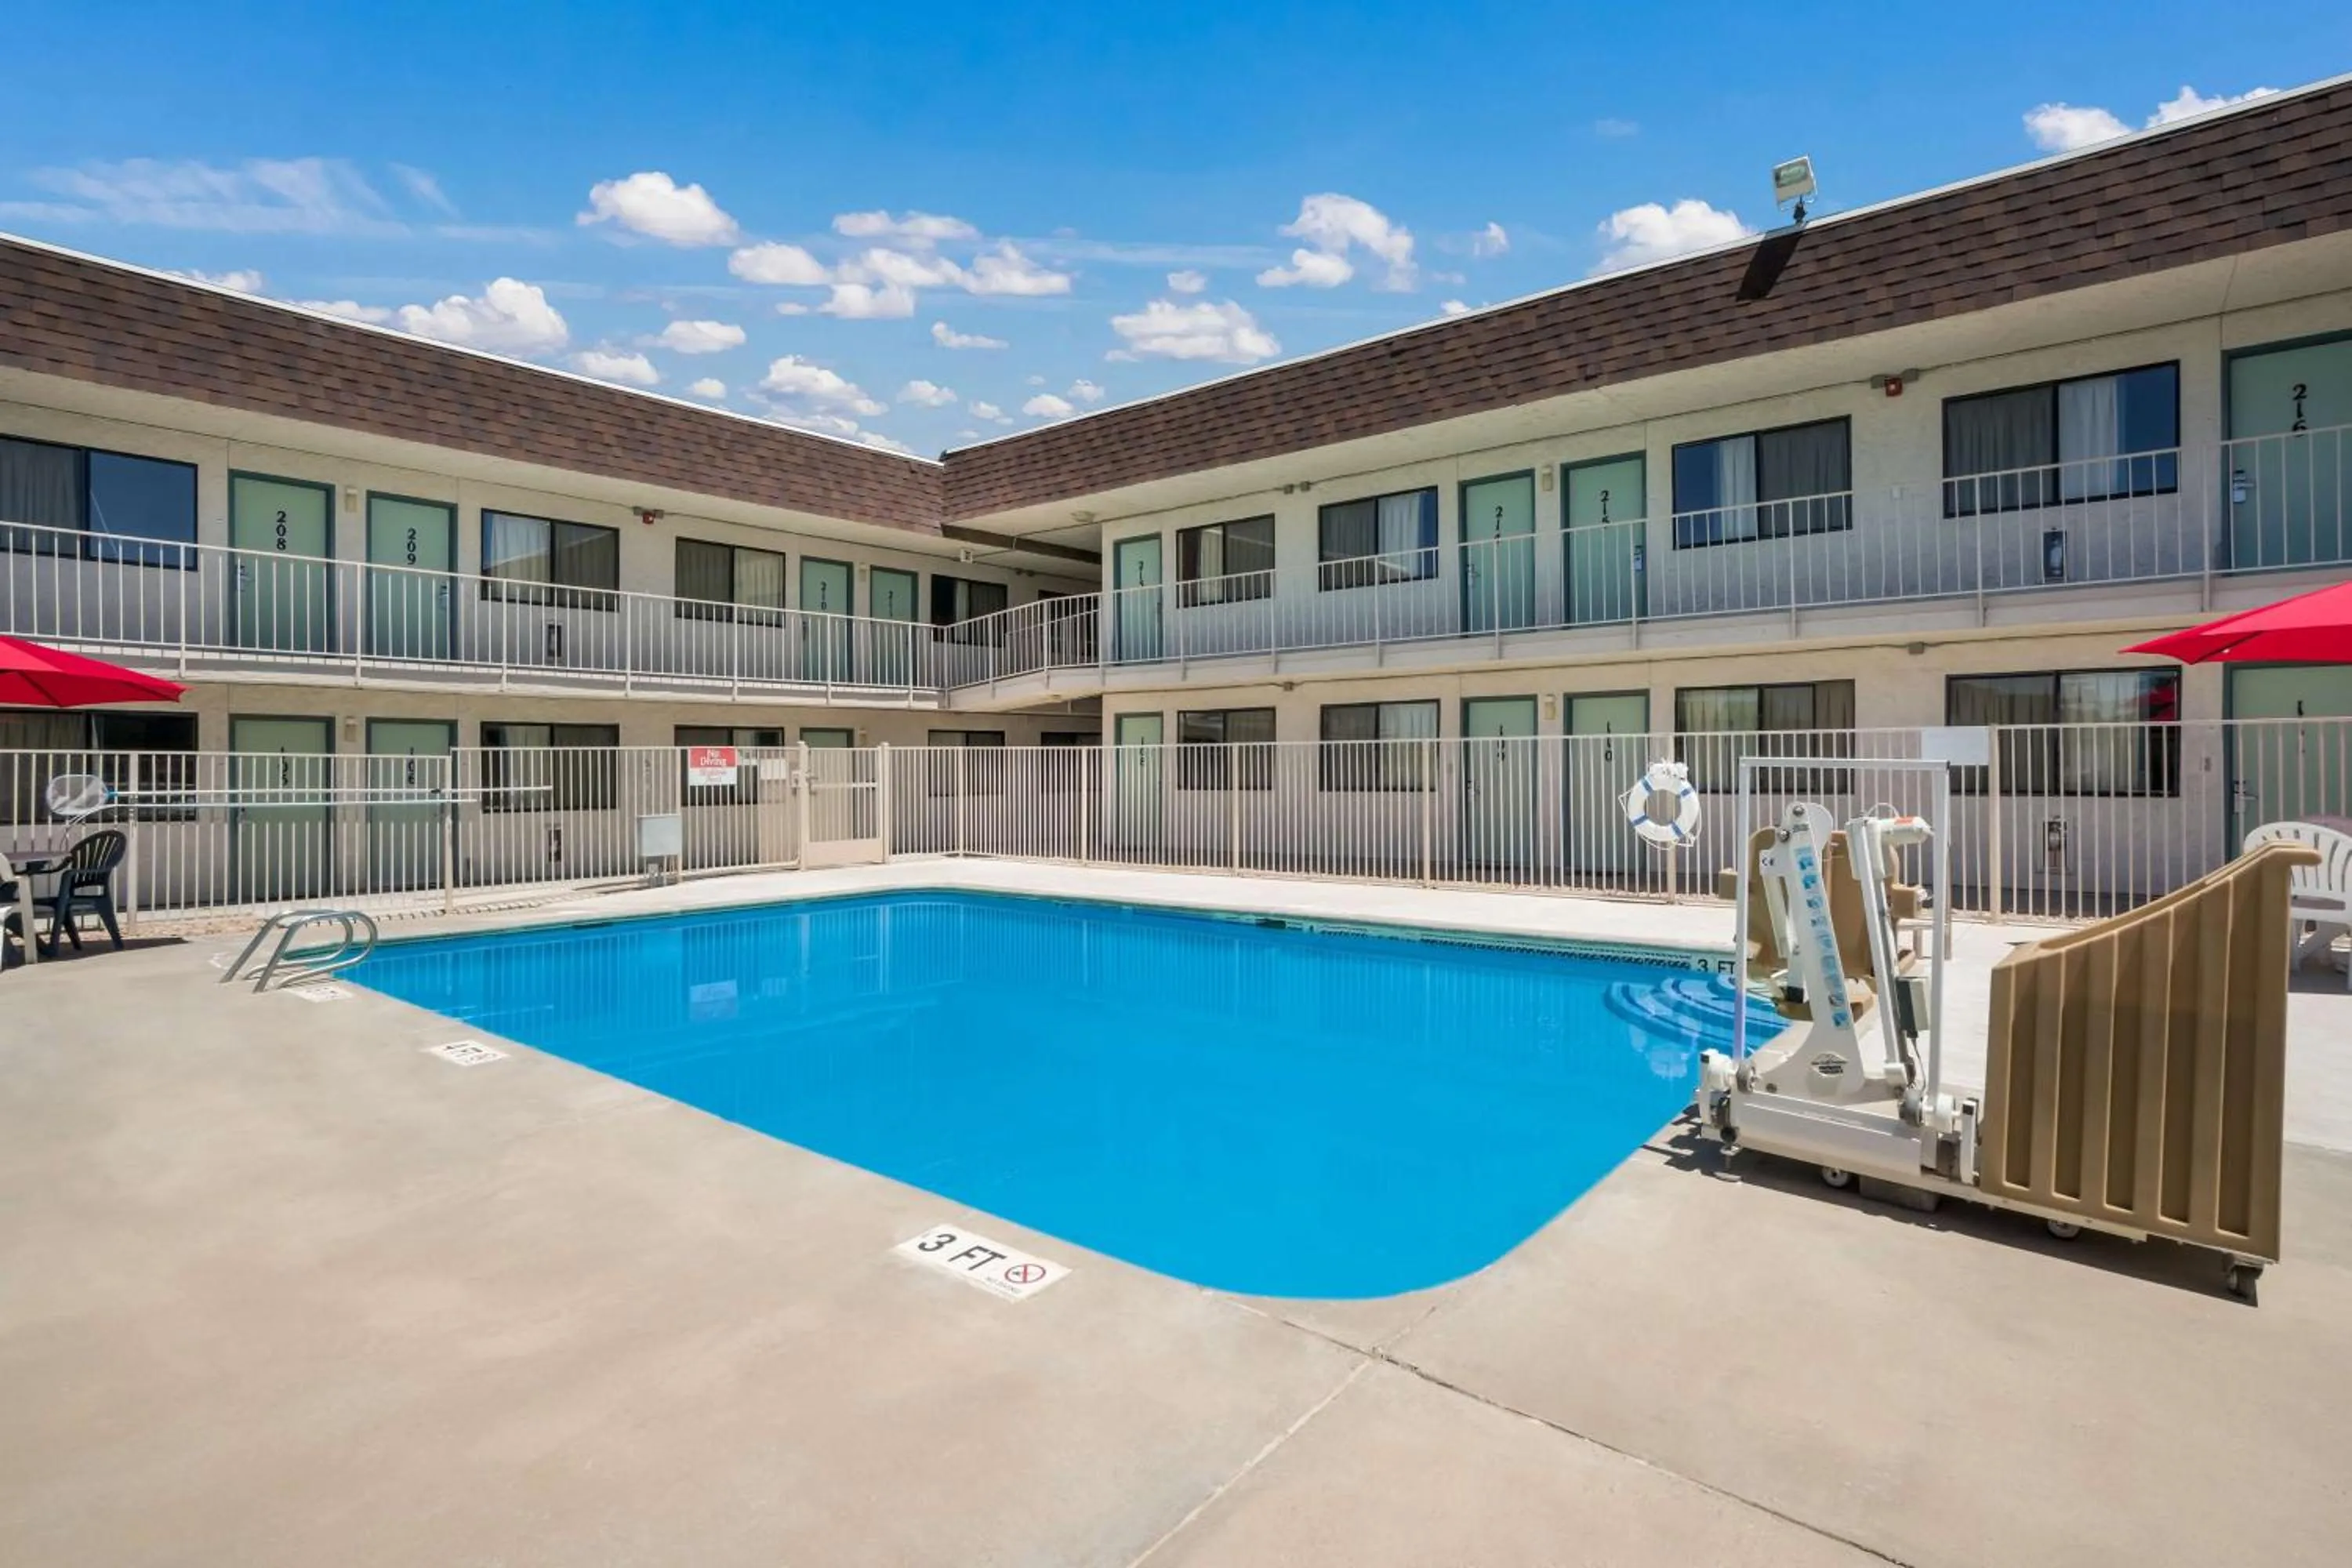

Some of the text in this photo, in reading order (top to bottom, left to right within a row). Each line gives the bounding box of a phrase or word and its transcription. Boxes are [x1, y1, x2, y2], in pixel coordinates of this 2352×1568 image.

[2292, 383, 2307, 437] 216
[276, 510, 286, 550] 208
[407, 528, 416, 565] 209
[1697, 959, 1736, 974] 3 FT
[918, 1233, 1007, 1271] 3 FT
